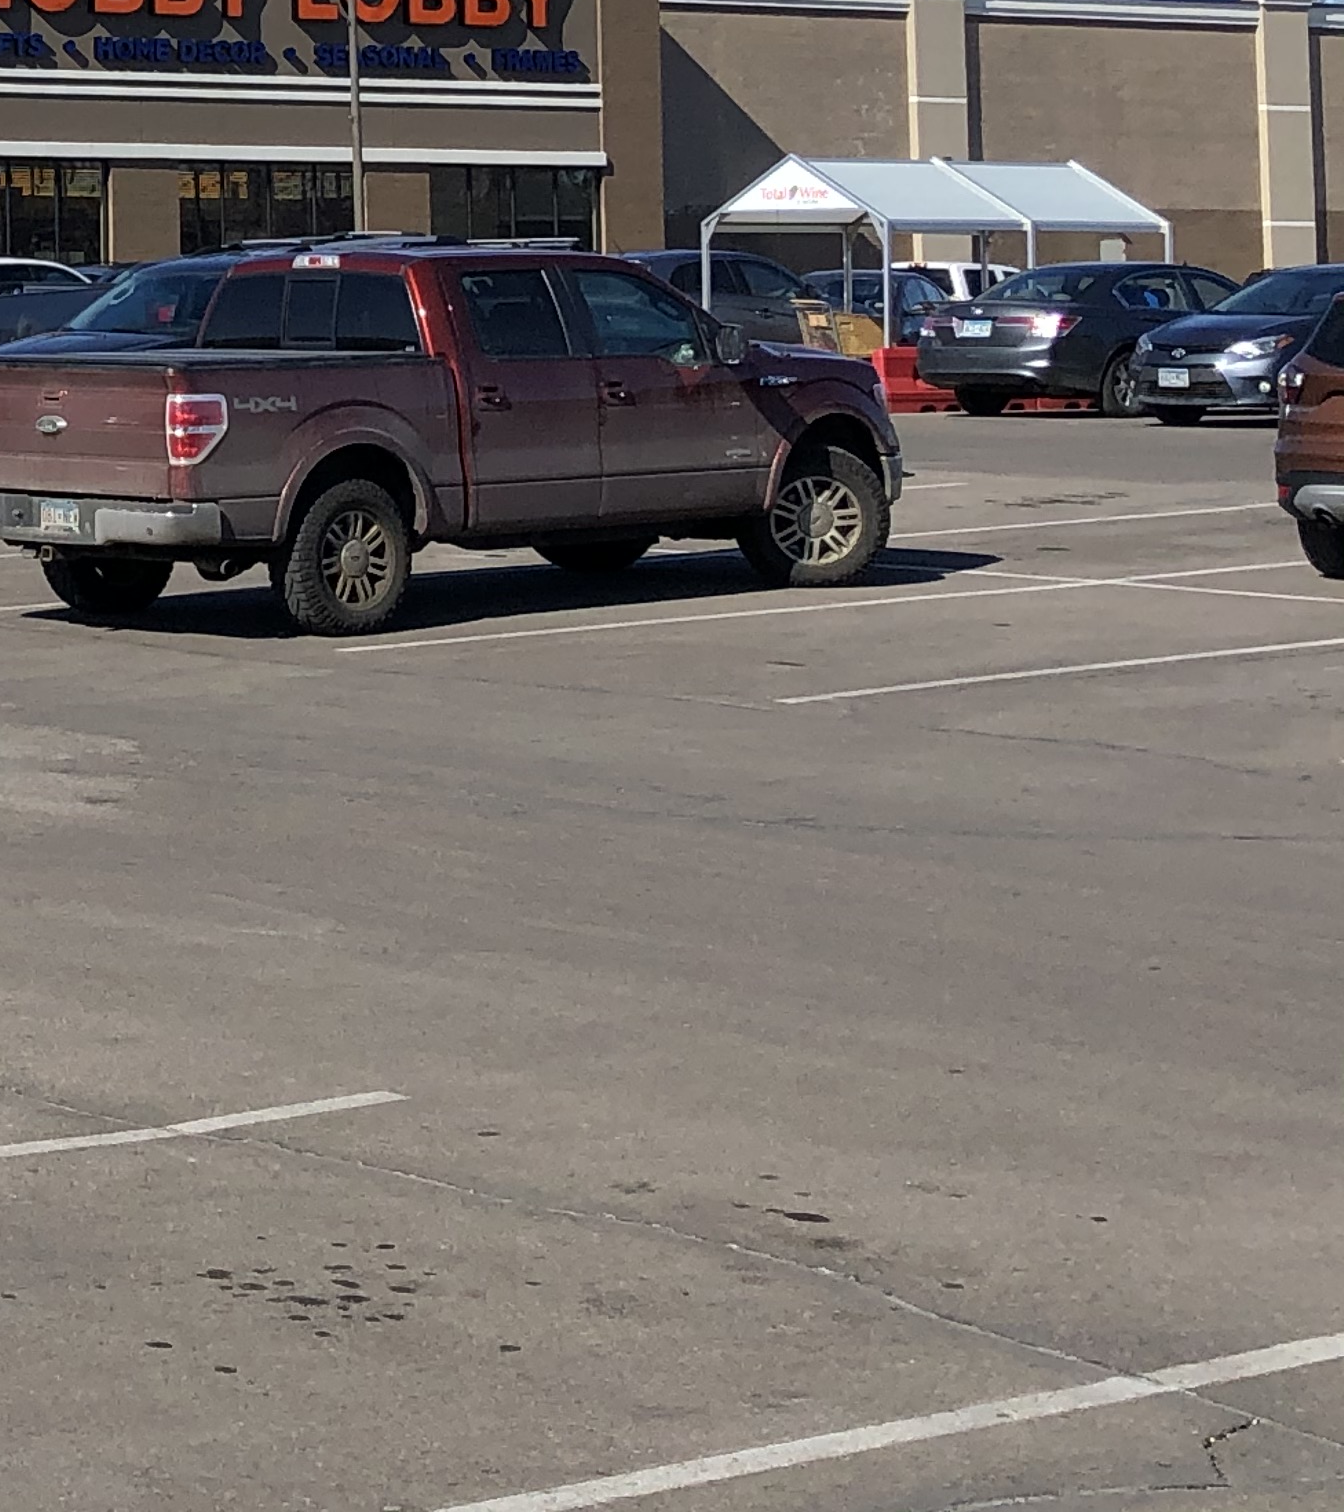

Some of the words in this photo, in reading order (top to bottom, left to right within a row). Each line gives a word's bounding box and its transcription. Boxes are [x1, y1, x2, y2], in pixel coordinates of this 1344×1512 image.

[93, 36, 171, 62] HOME
[179, 39, 268, 65] DECOR
[491, 48, 581, 74] FRAMES
